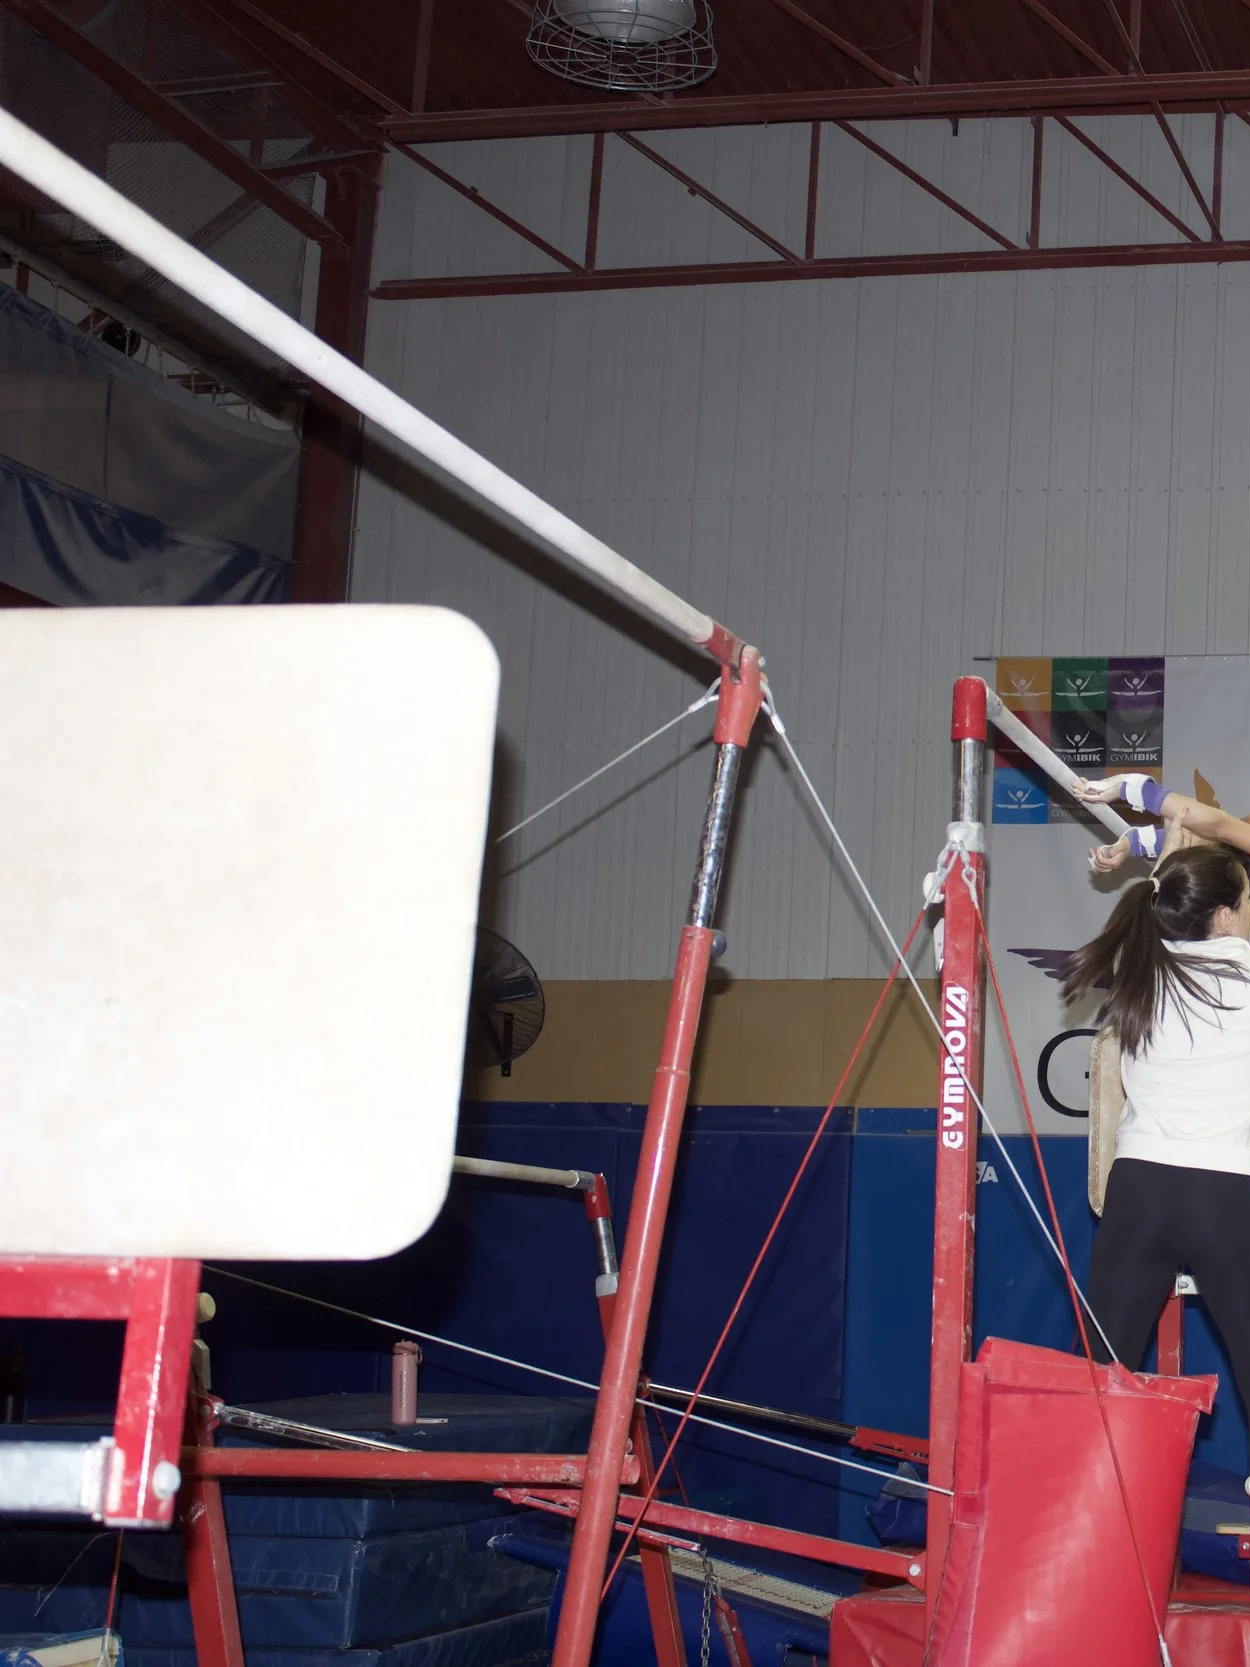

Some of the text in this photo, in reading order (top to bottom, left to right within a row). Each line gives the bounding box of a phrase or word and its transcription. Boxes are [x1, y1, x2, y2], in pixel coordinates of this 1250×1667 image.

[1059, 753, 1101, 762] YMIBIK
[1110, 753, 1158, 761] GYMIBIK
[942, 985, 970, 1149] GYMNOVA
